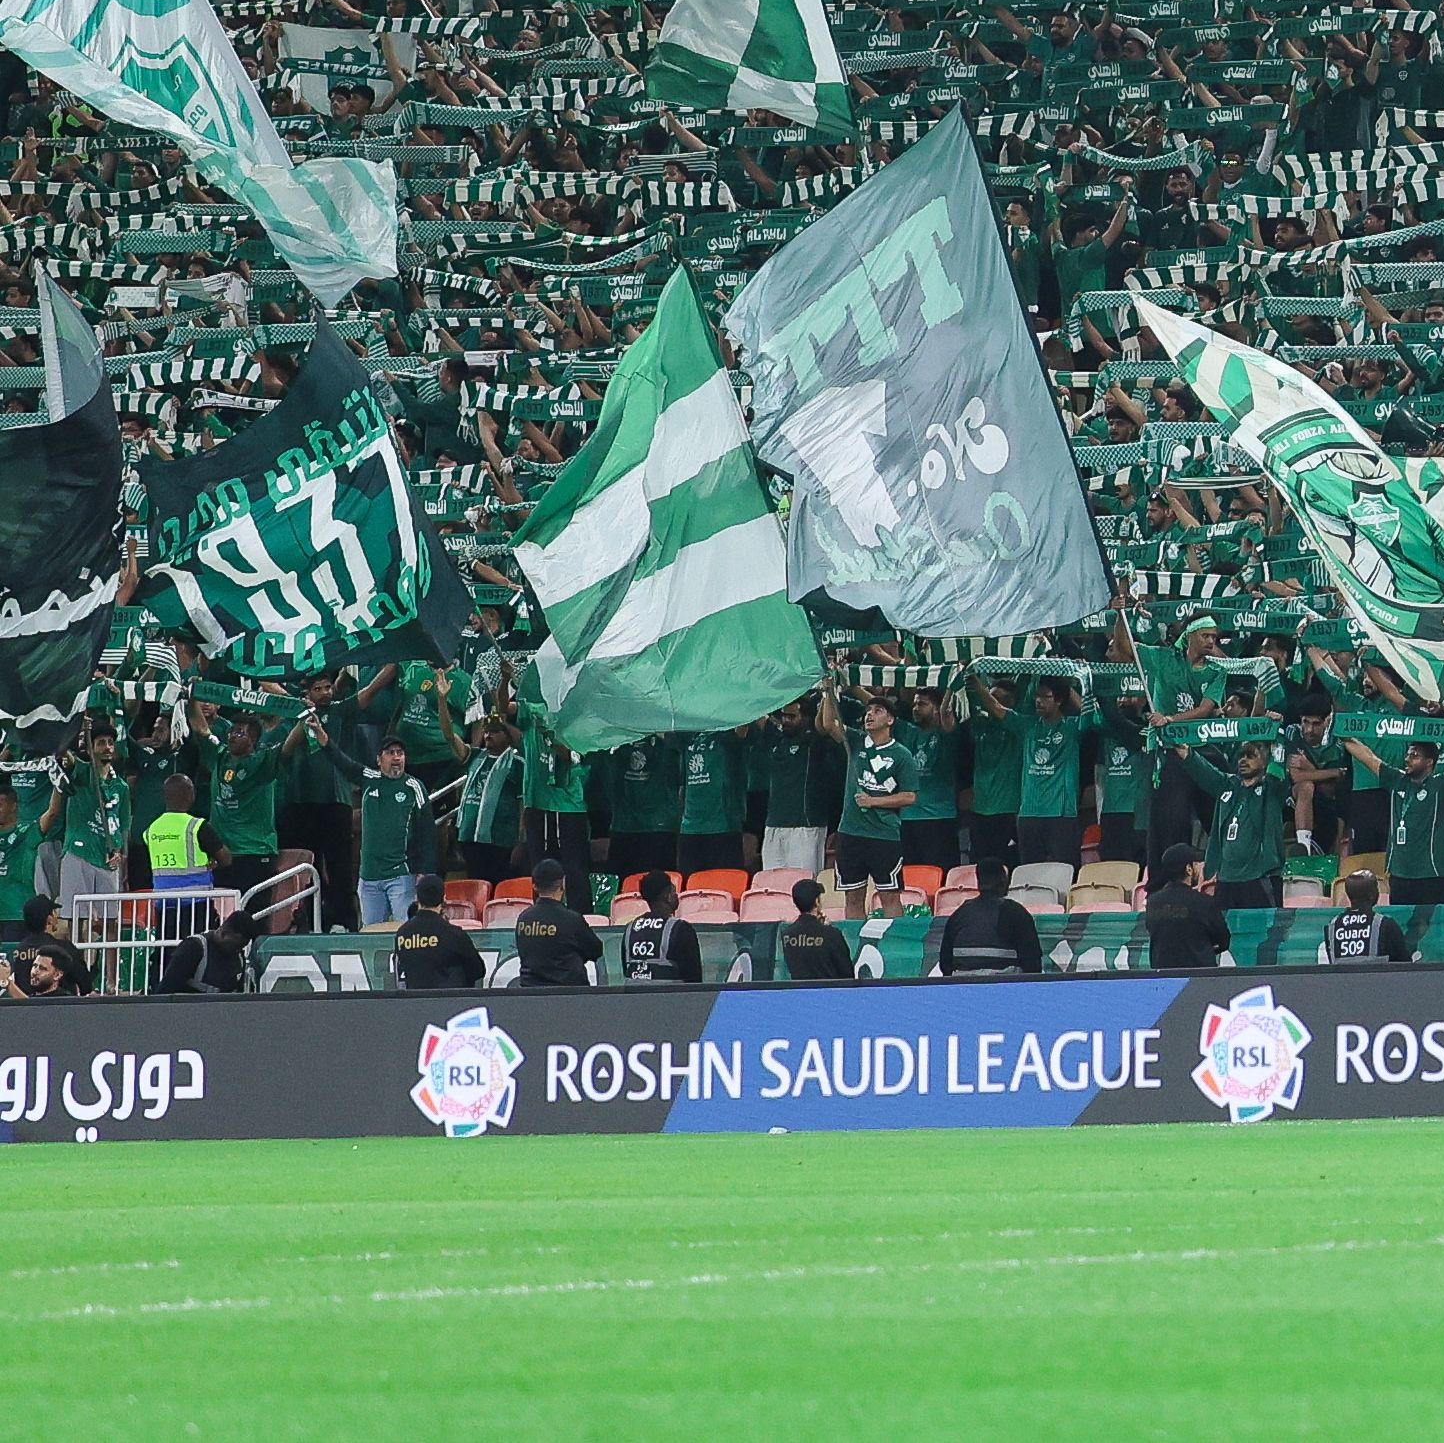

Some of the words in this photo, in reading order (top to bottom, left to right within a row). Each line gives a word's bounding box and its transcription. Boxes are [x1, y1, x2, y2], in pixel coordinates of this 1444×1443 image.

[150, 832, 181, 842] Organizer
[155, 854, 177, 868] 133
[634, 918, 663, 931] EPIC
[1343, 915, 1367, 925] EPIC
[518, 921, 557, 937] Police
[1336, 925, 1371, 941] Guard
[397, 934, 438, 950] Police
[632, 941, 655, 956] 662
[784, 934, 824, 948] Police
[1341, 940, 1364, 956] 509
[632, 970, 652, 981] Guard
[547, 1041, 741, 1101] ROSHN
[766, 1036, 928, 1097] SAUDI
[948, 1030, 1161, 1093] LEAGUE
[1233, 1047, 1269, 1068] RSL
[450, 1066, 484, 1085] RSL
[63, 1050, 203, 1142] دوري
